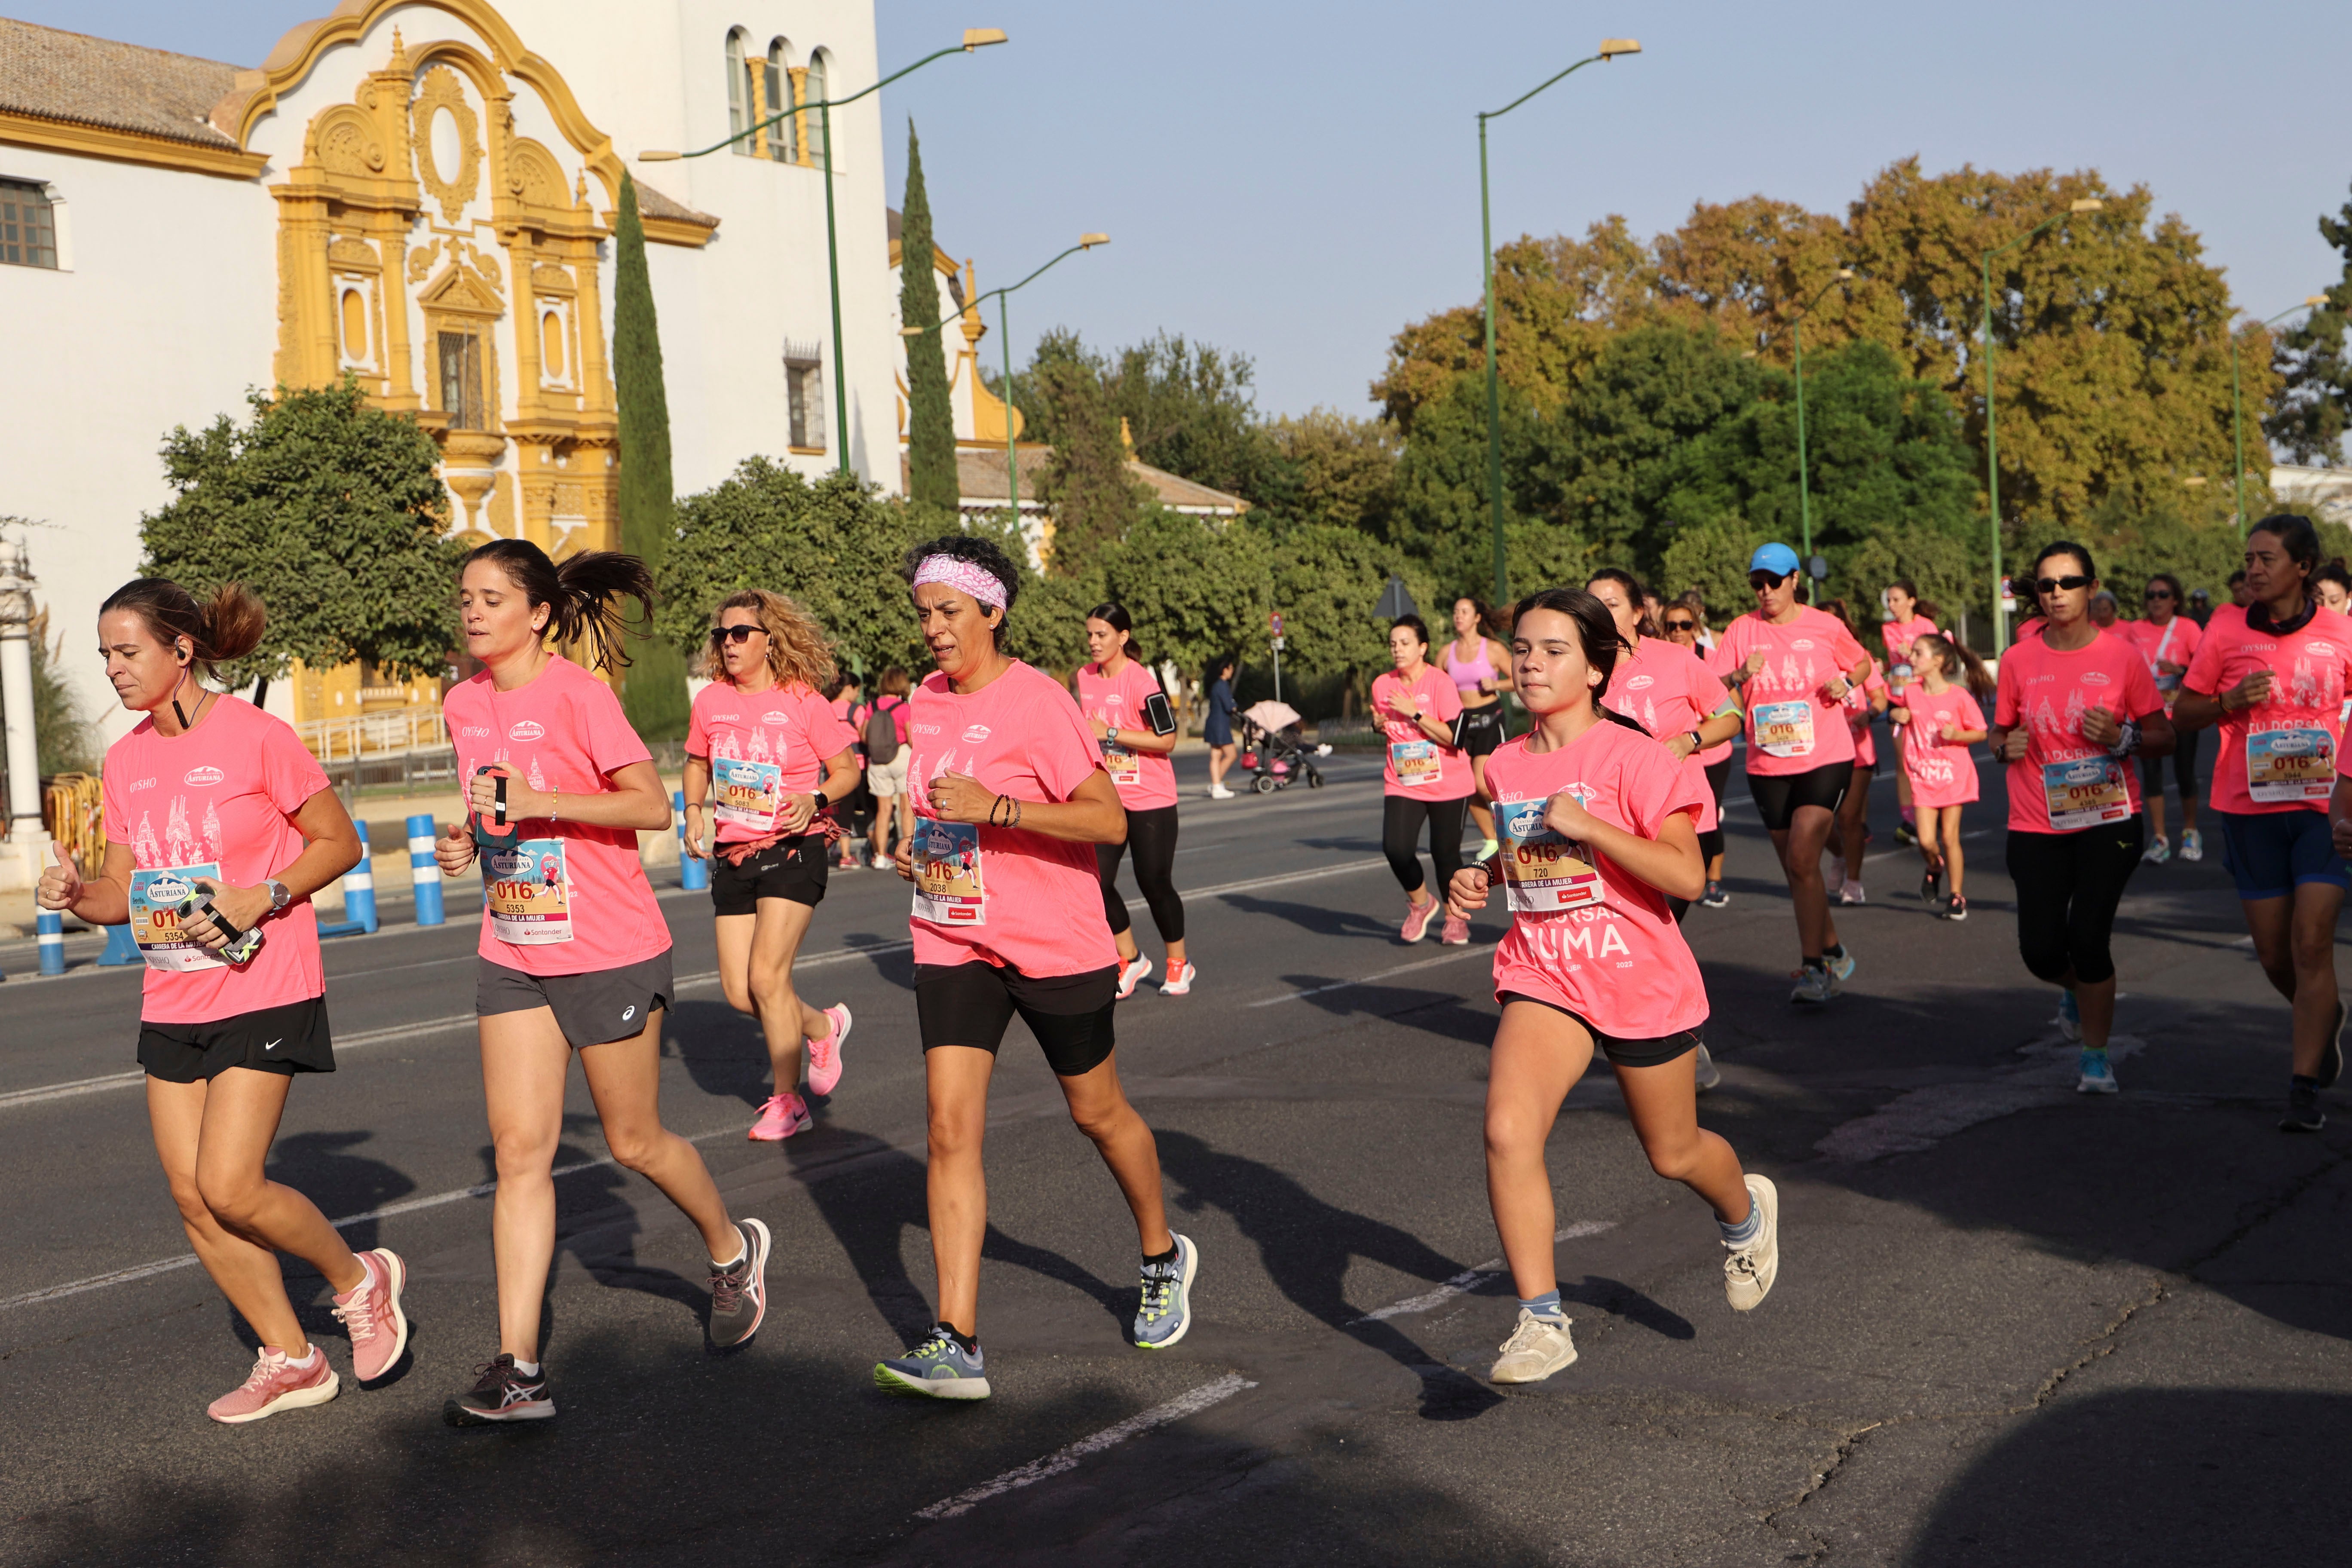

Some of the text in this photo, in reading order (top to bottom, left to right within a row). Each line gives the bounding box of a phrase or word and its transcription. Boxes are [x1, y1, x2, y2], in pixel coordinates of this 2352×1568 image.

[462, 726, 490, 737] OYSHO
[913, 723, 940, 735] OYSHO
[2275, 756, 2309, 770] 016
[731, 771, 757, 780] ASTURIANA
[130, 777, 156, 793] OYSHO
[729, 785, 756, 799] 016
[2070, 783, 2102, 799] 016
[1513, 822, 1544, 832] ASTURIA
[1517, 842, 1557, 864] 016
[494, 860, 530, 869] ASTURIANA
[1533, 868, 1548, 878] 720
[1553, 878, 1572, 886] MUJER
[150, 888, 186, 897] ASTURIANA
[497, 881, 533, 899] 016
[930, 883, 946, 893] 2038
[506, 904, 525, 913] 5353
[918, 902, 933, 913] OYSHO
[153, 909, 182, 928] 01
[495, 924, 510, 935] OYSHO
[165, 932, 184, 941] 5354
[192, 952, 223, 961] Santande
